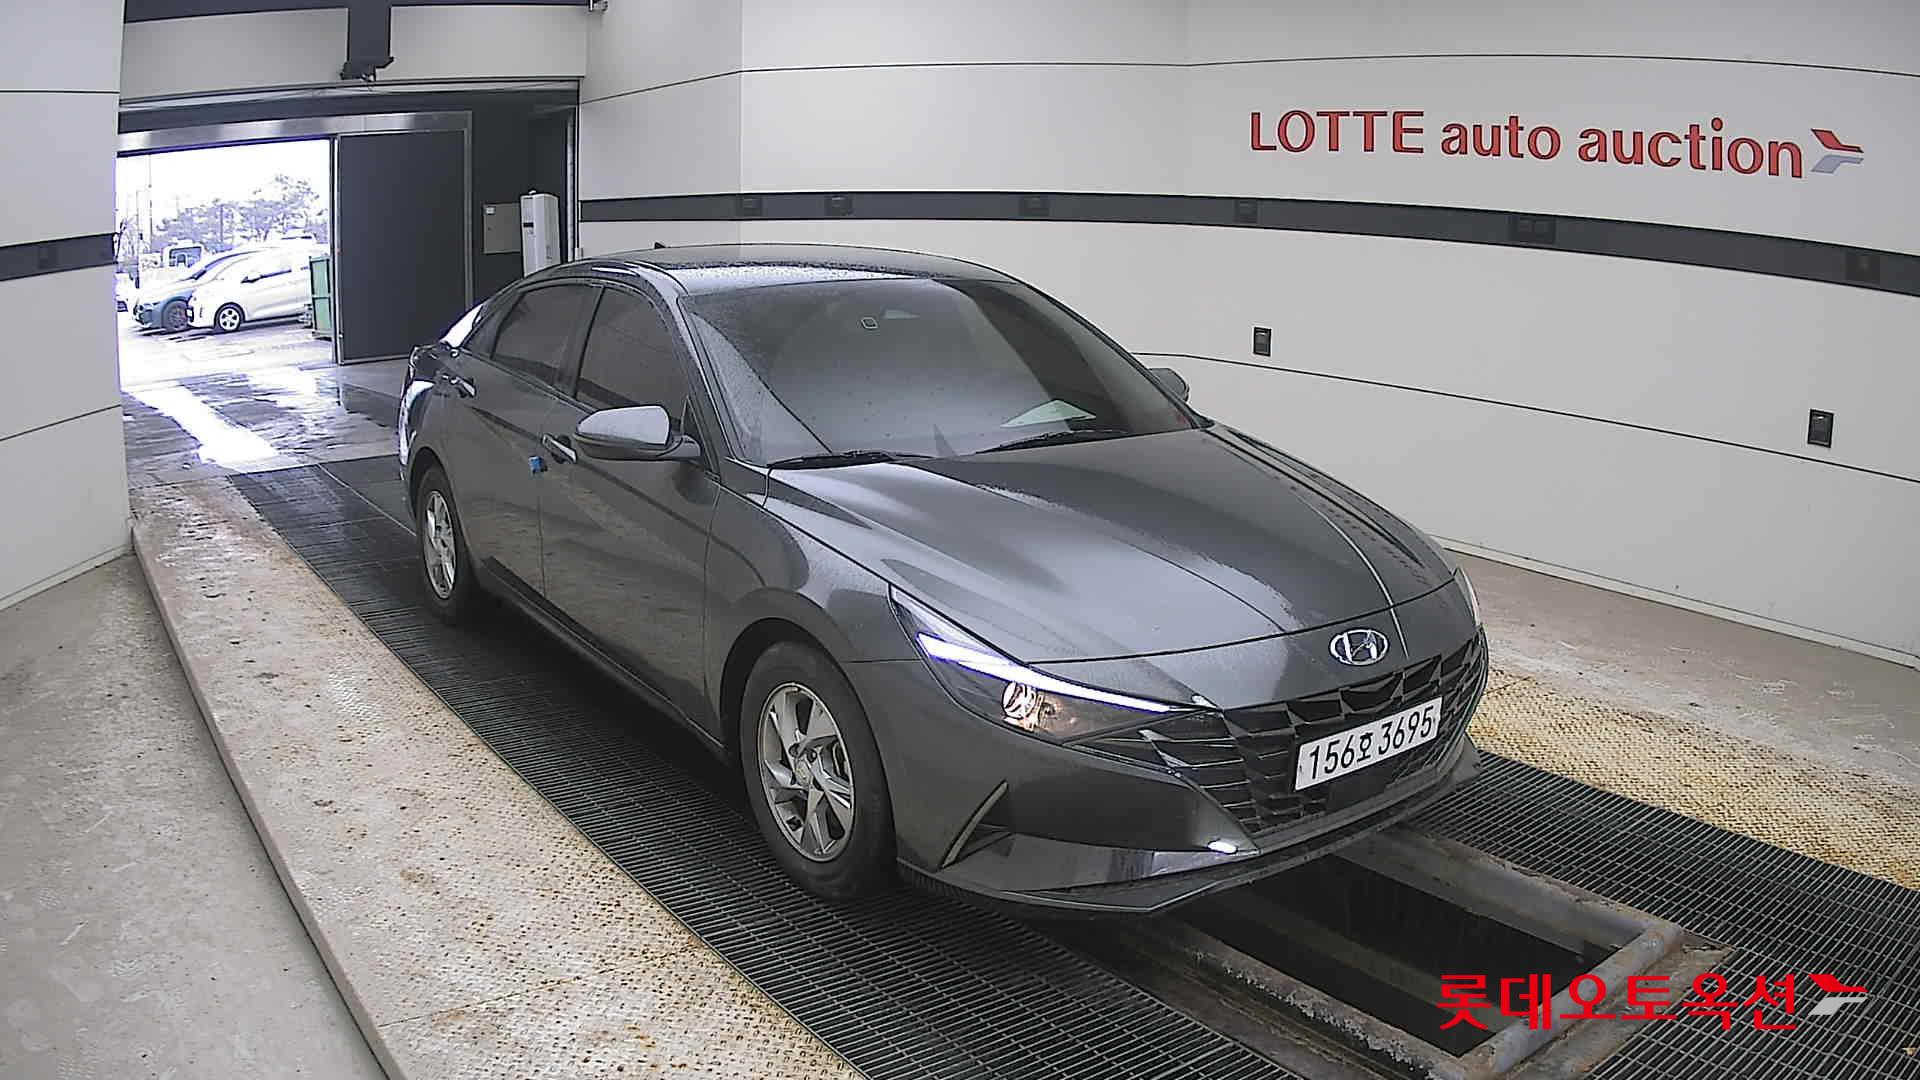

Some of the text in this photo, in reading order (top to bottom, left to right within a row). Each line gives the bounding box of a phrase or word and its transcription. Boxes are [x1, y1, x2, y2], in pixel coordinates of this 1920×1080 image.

[1250, 110, 1804, 179] LOTTE auto auction
